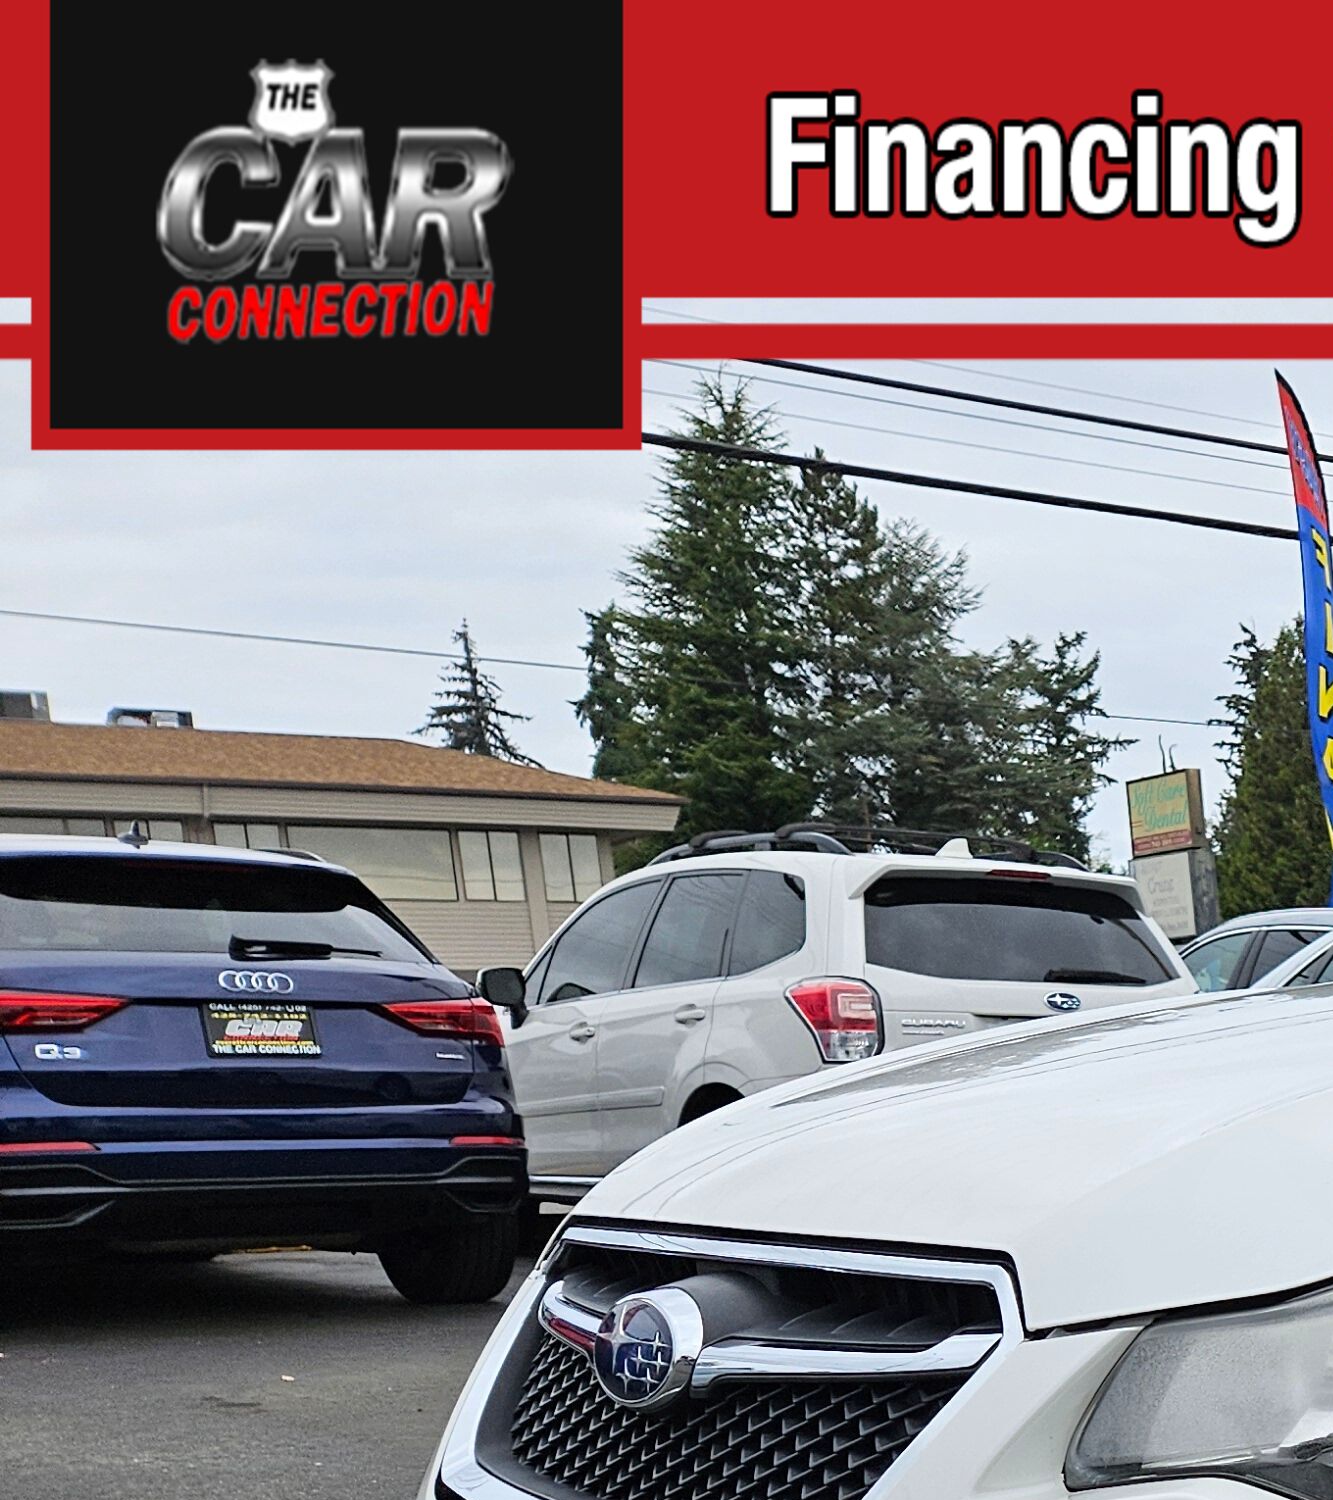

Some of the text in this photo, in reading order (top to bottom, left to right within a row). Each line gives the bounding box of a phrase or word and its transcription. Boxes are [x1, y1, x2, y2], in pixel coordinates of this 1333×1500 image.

[1145, 800, 1187, 831] Dental
[209, 1003, 236, 1012] CALL
[225, 1019, 303, 1037] CAR
[902, 1019, 966, 1029] SUBARU
[35, 1043, 81, 1060] Q3
[212, 1044, 322, 1055] THE CAR CONNECTION
